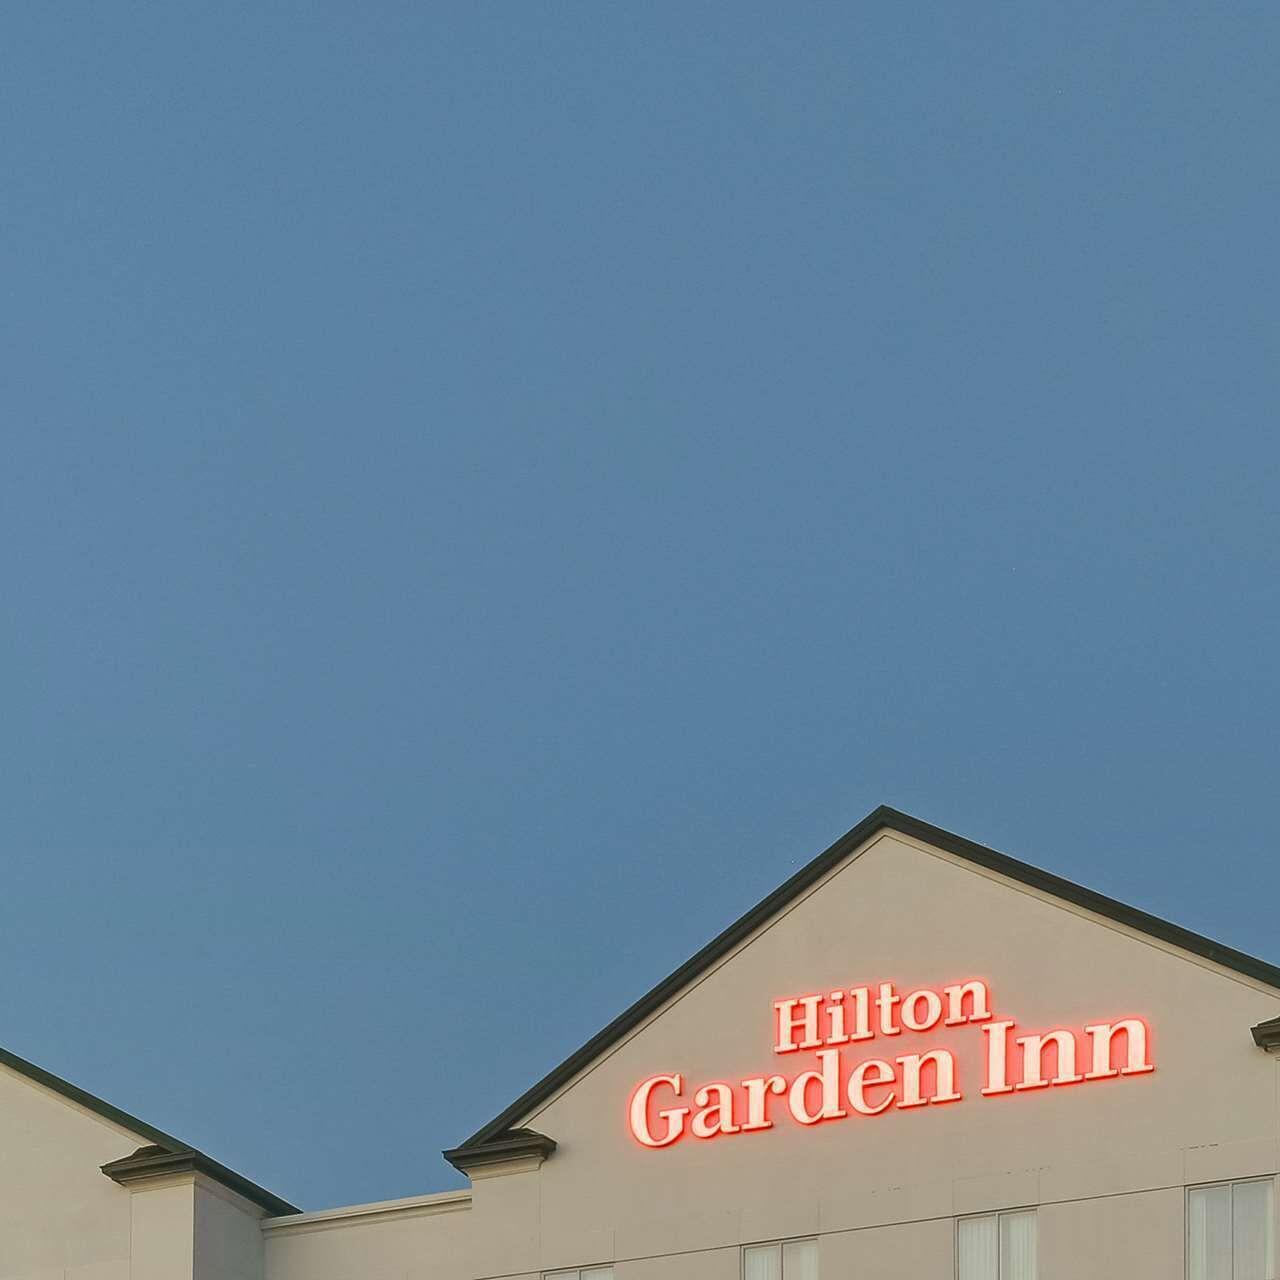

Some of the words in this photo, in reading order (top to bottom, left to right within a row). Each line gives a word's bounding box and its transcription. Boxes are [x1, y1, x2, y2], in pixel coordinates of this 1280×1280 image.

[773, 979, 992, 1053] Hilton
[629, 1048, 961, 1147] Garden
[979, 1016, 1155, 1097] Inn
